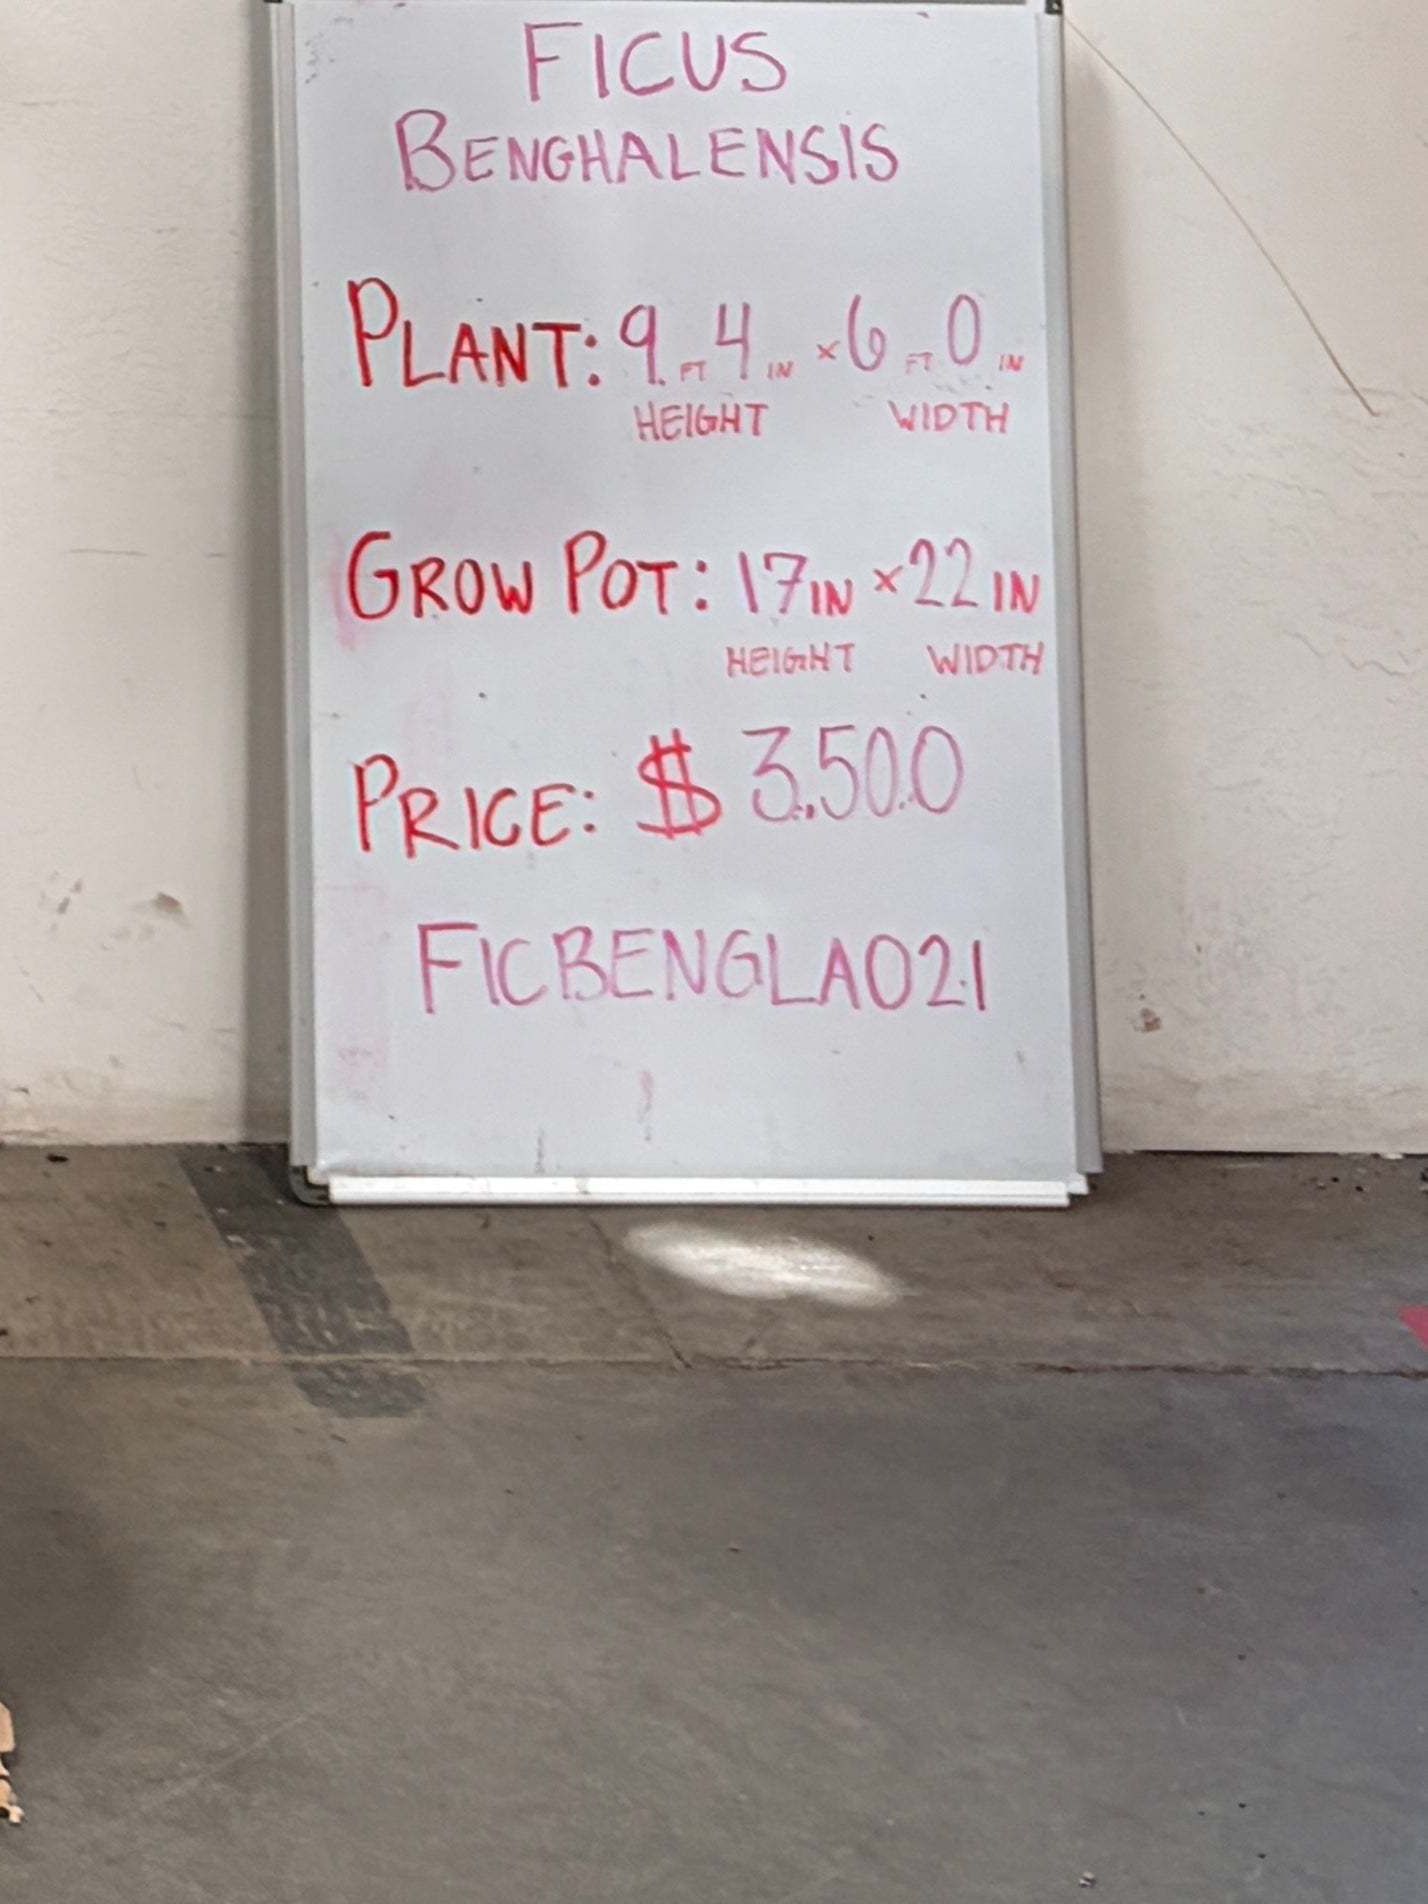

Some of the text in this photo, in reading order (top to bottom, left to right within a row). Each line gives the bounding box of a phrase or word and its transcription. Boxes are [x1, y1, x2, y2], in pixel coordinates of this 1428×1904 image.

[524, 22, 787, 103] FICUS
[394, 110, 899, 191] BENGHALENSIS
[346, 277, 602, 390] PLANT:
[715, 302, 751, 380] 4
[846, 294, 886, 372] 6
[634, 401, 768, 441] HEIGHT
[889, 401, 1010, 433] WIDTH
[347, 530, 535, 622] GROW
[562, 529, 709, 617] POT:
[725, 643, 855, 677] HEIGHT
[926, 642, 1044, 676] WIDTH
[353, 753, 597, 860] PRICE:
